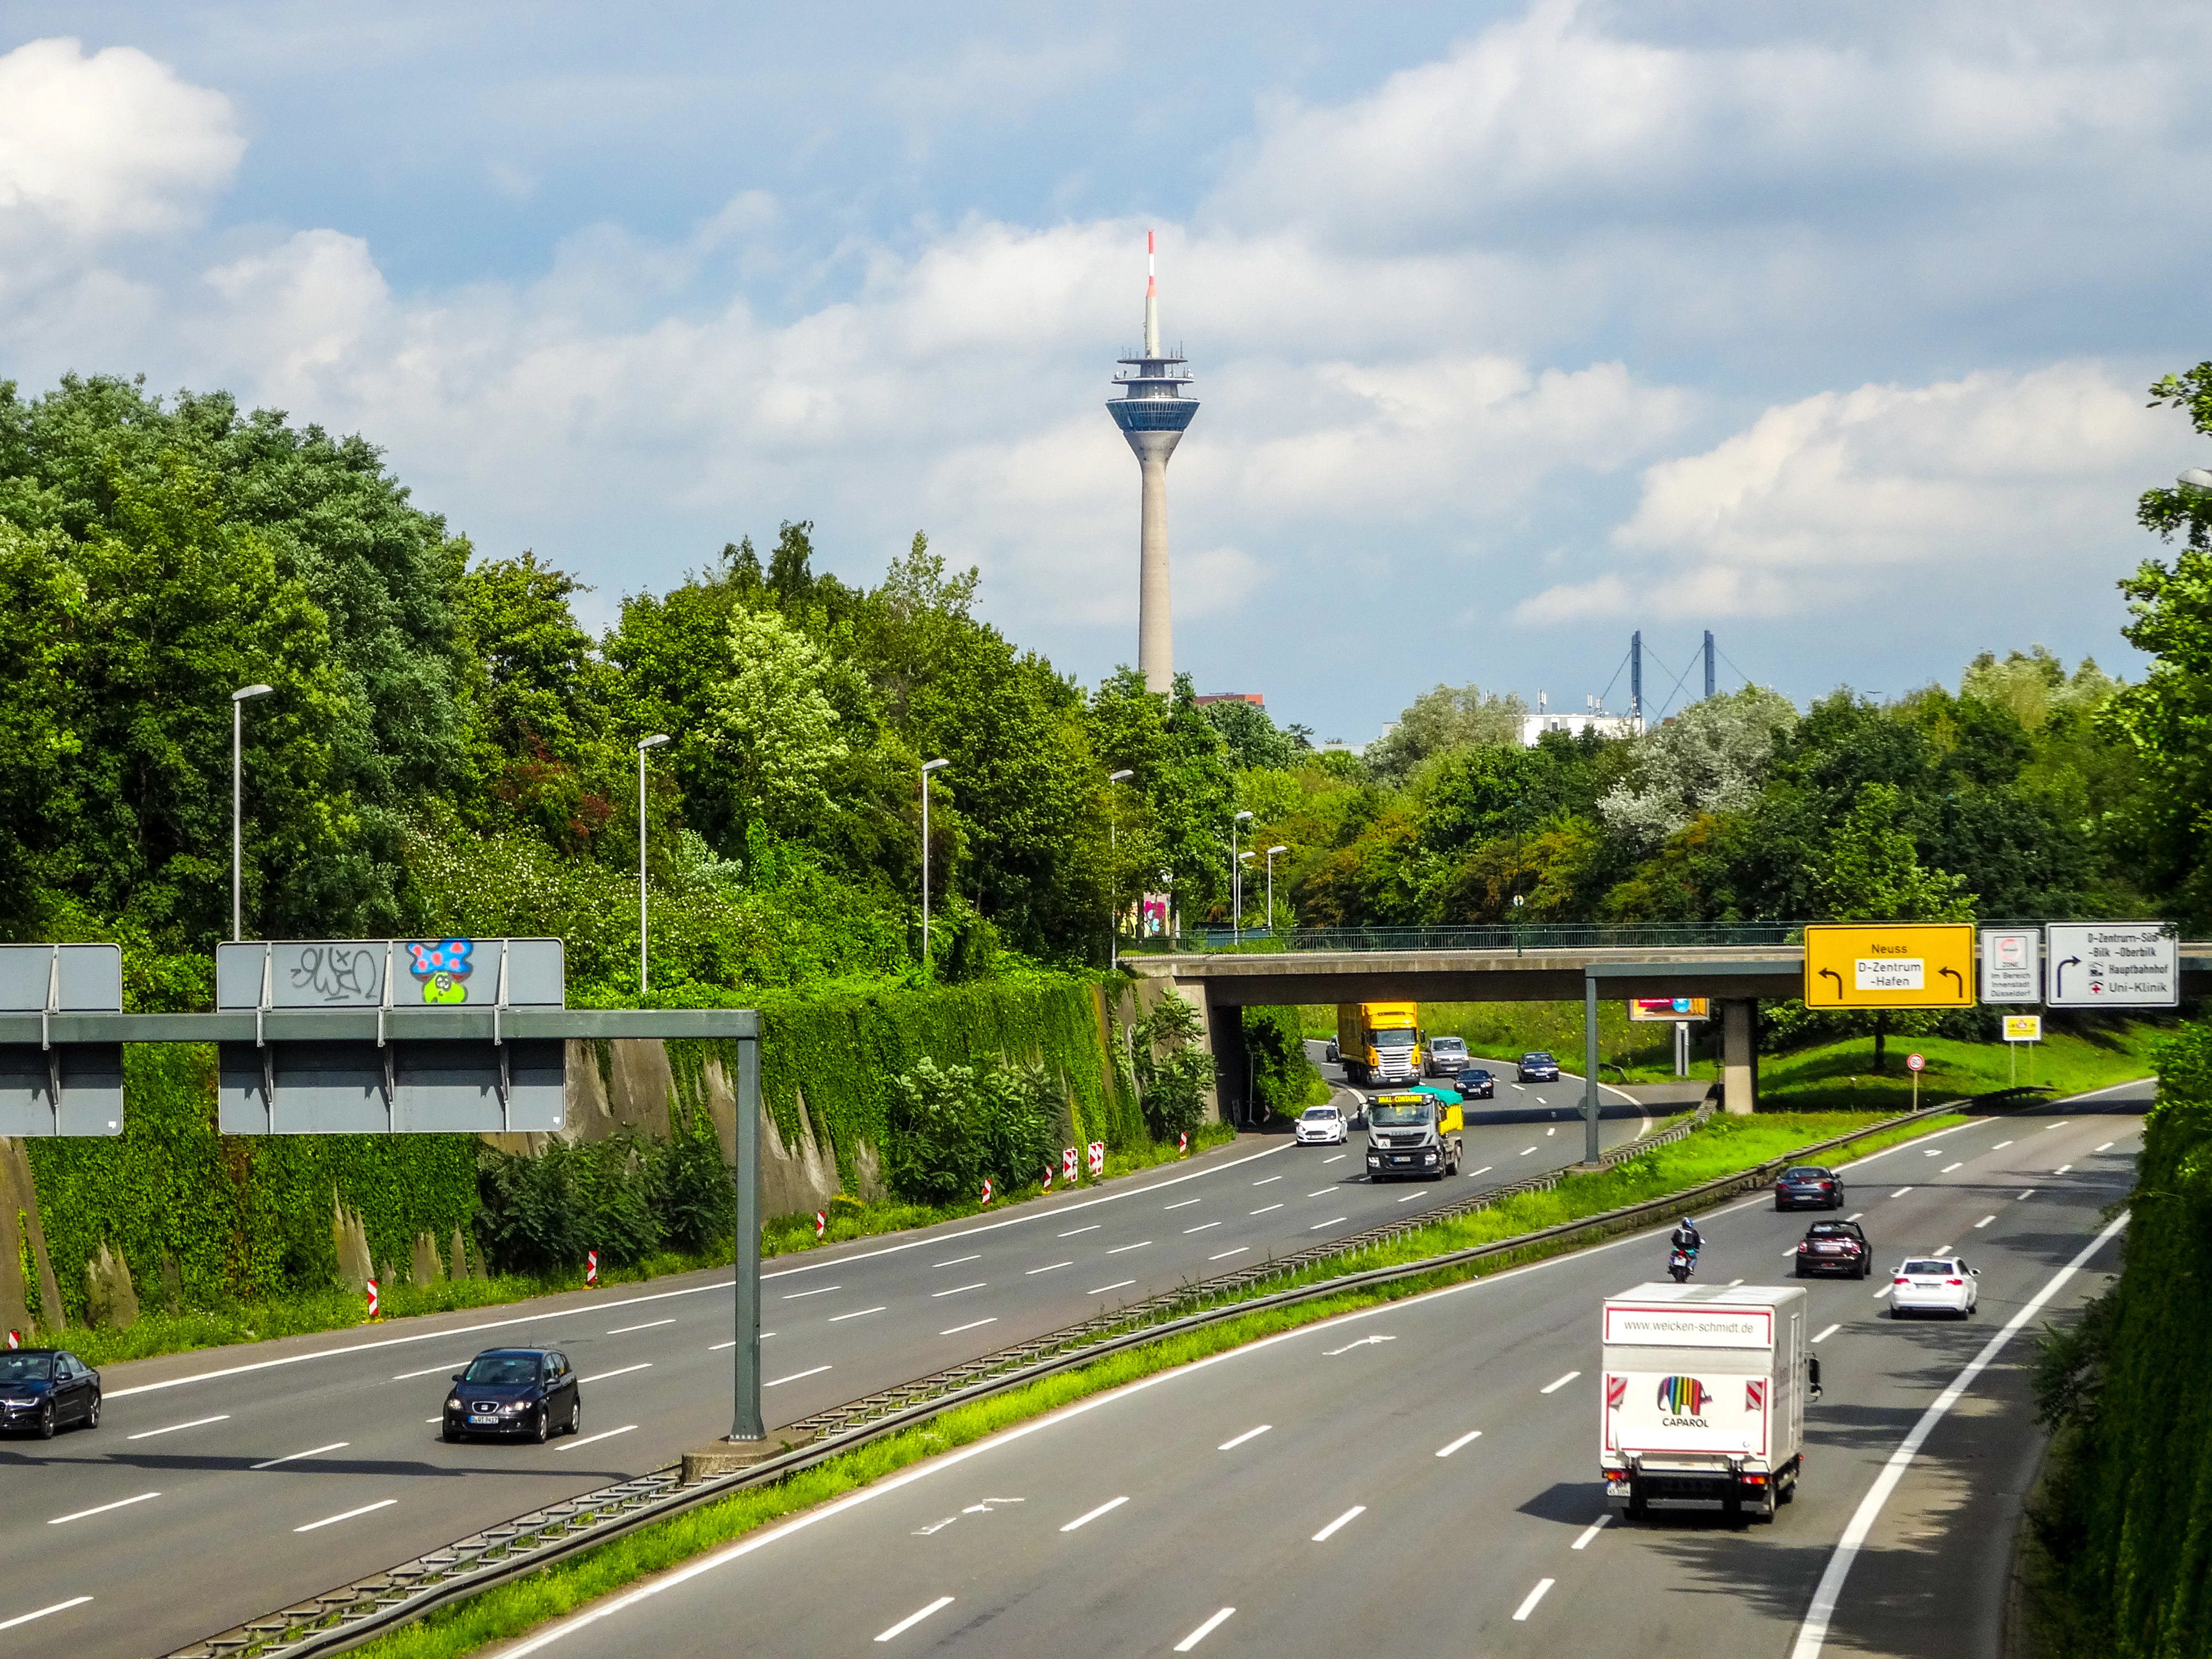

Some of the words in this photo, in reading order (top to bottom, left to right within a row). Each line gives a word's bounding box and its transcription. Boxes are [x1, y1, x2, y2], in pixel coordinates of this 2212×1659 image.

[1871, 944, 1907, 953] Neuss
[2089, 948, 2110, 957] -Bilk
[2115, 947, 2156, 957] -Oberbilk
[1859, 962, 1921, 972] D-Zentrum
[2109, 964, 2168, 976] Hauptbahnhof
[1870, 977, 1910, 985] -Hafen
[2109, 982, 2167, 993] Uni-Klinik
[1624, 1321, 1754, 1333] www.weicken-schmidt.de
[1662, 1417, 1709, 1428] CAPAROL
